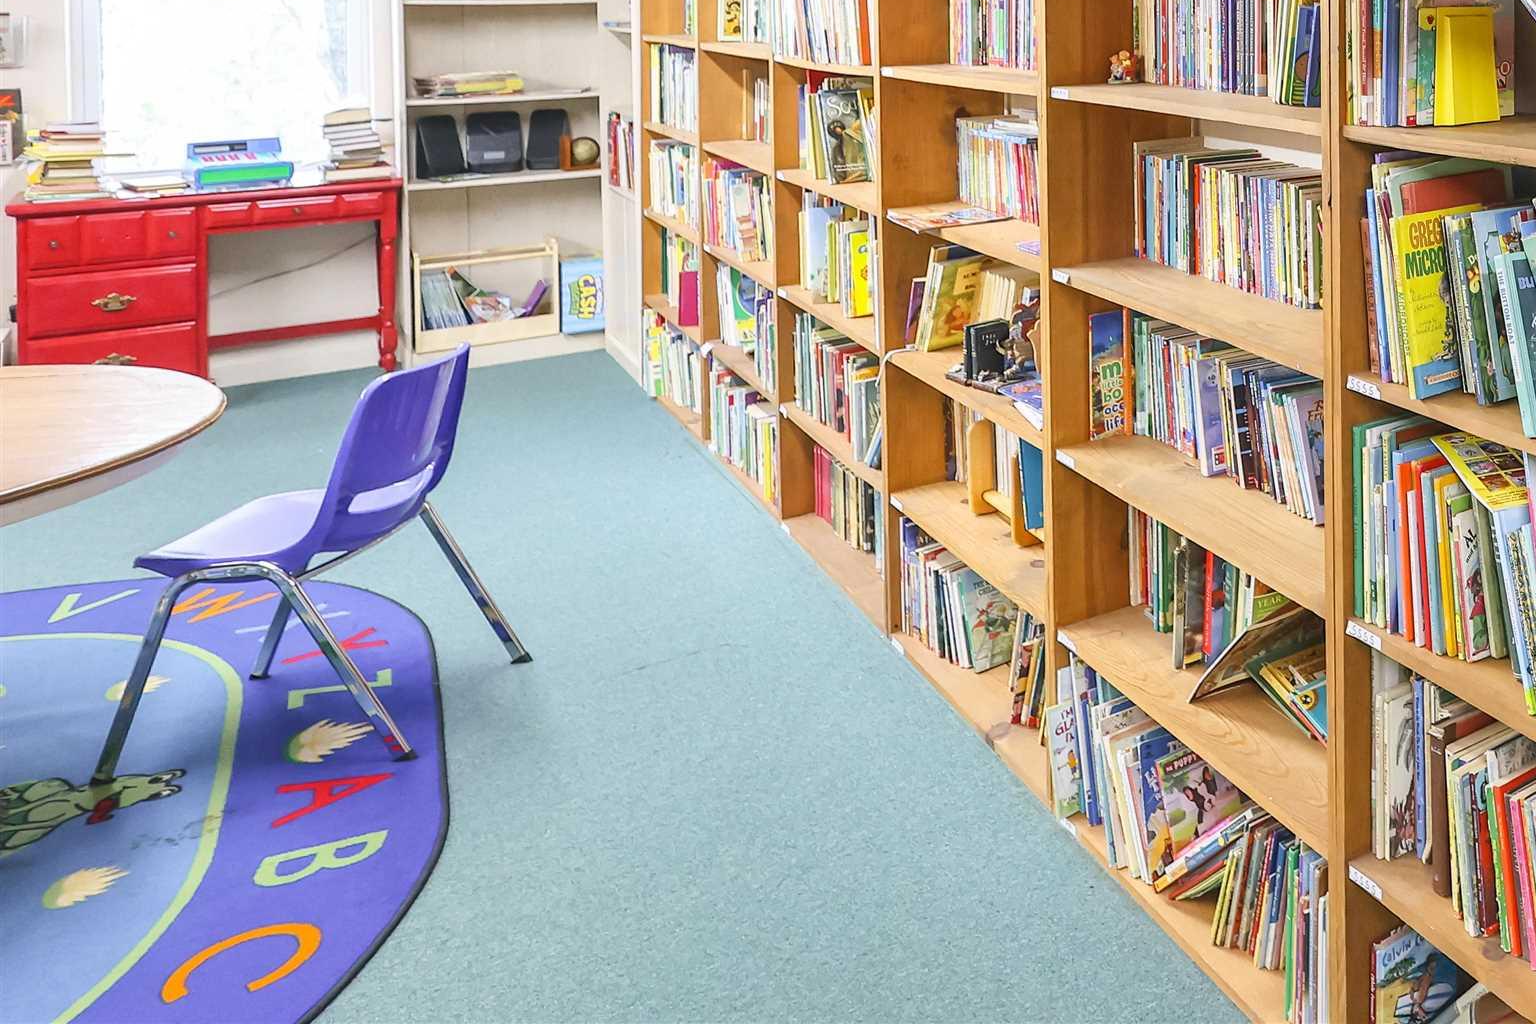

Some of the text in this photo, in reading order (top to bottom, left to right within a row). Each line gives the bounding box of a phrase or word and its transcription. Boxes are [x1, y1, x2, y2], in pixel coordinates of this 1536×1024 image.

[271, 771, 396, 829] A
[252, 829, 390, 888] B
[160, 921, 322, 1005] C
